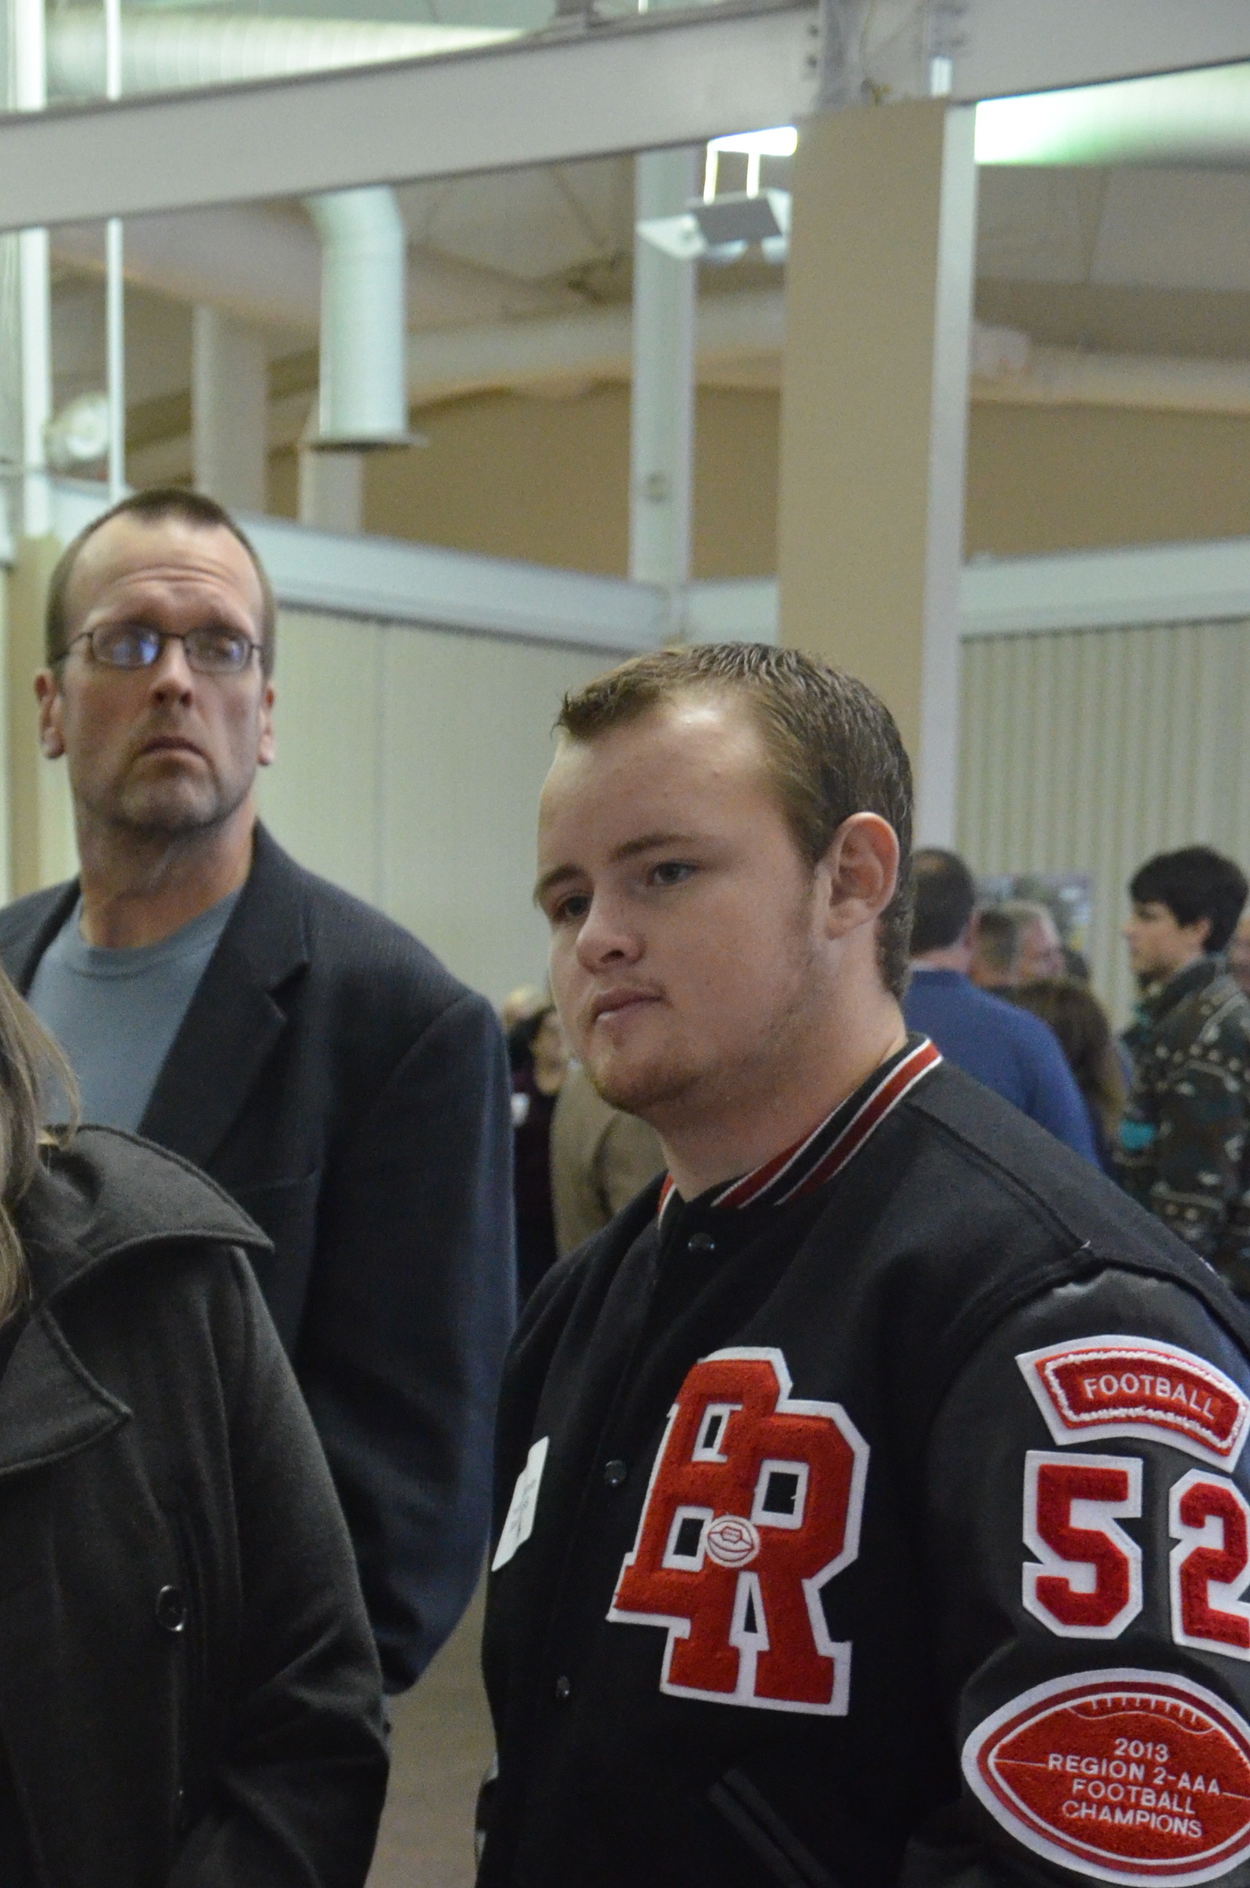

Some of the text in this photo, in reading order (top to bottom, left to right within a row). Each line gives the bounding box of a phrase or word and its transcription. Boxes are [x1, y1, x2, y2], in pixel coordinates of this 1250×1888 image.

[1083, 1374, 1215, 1419] FOOTBALL
[1023, 1450, 1250, 1662] 52
[1114, 1737, 1169, 1763] 2013
[1048, 1753, 1220, 1796] REGION 2-AAA
[1072, 1778, 1196, 1815] FOOTBALL
[1062, 1800, 1203, 1838] CHAMPIONS
